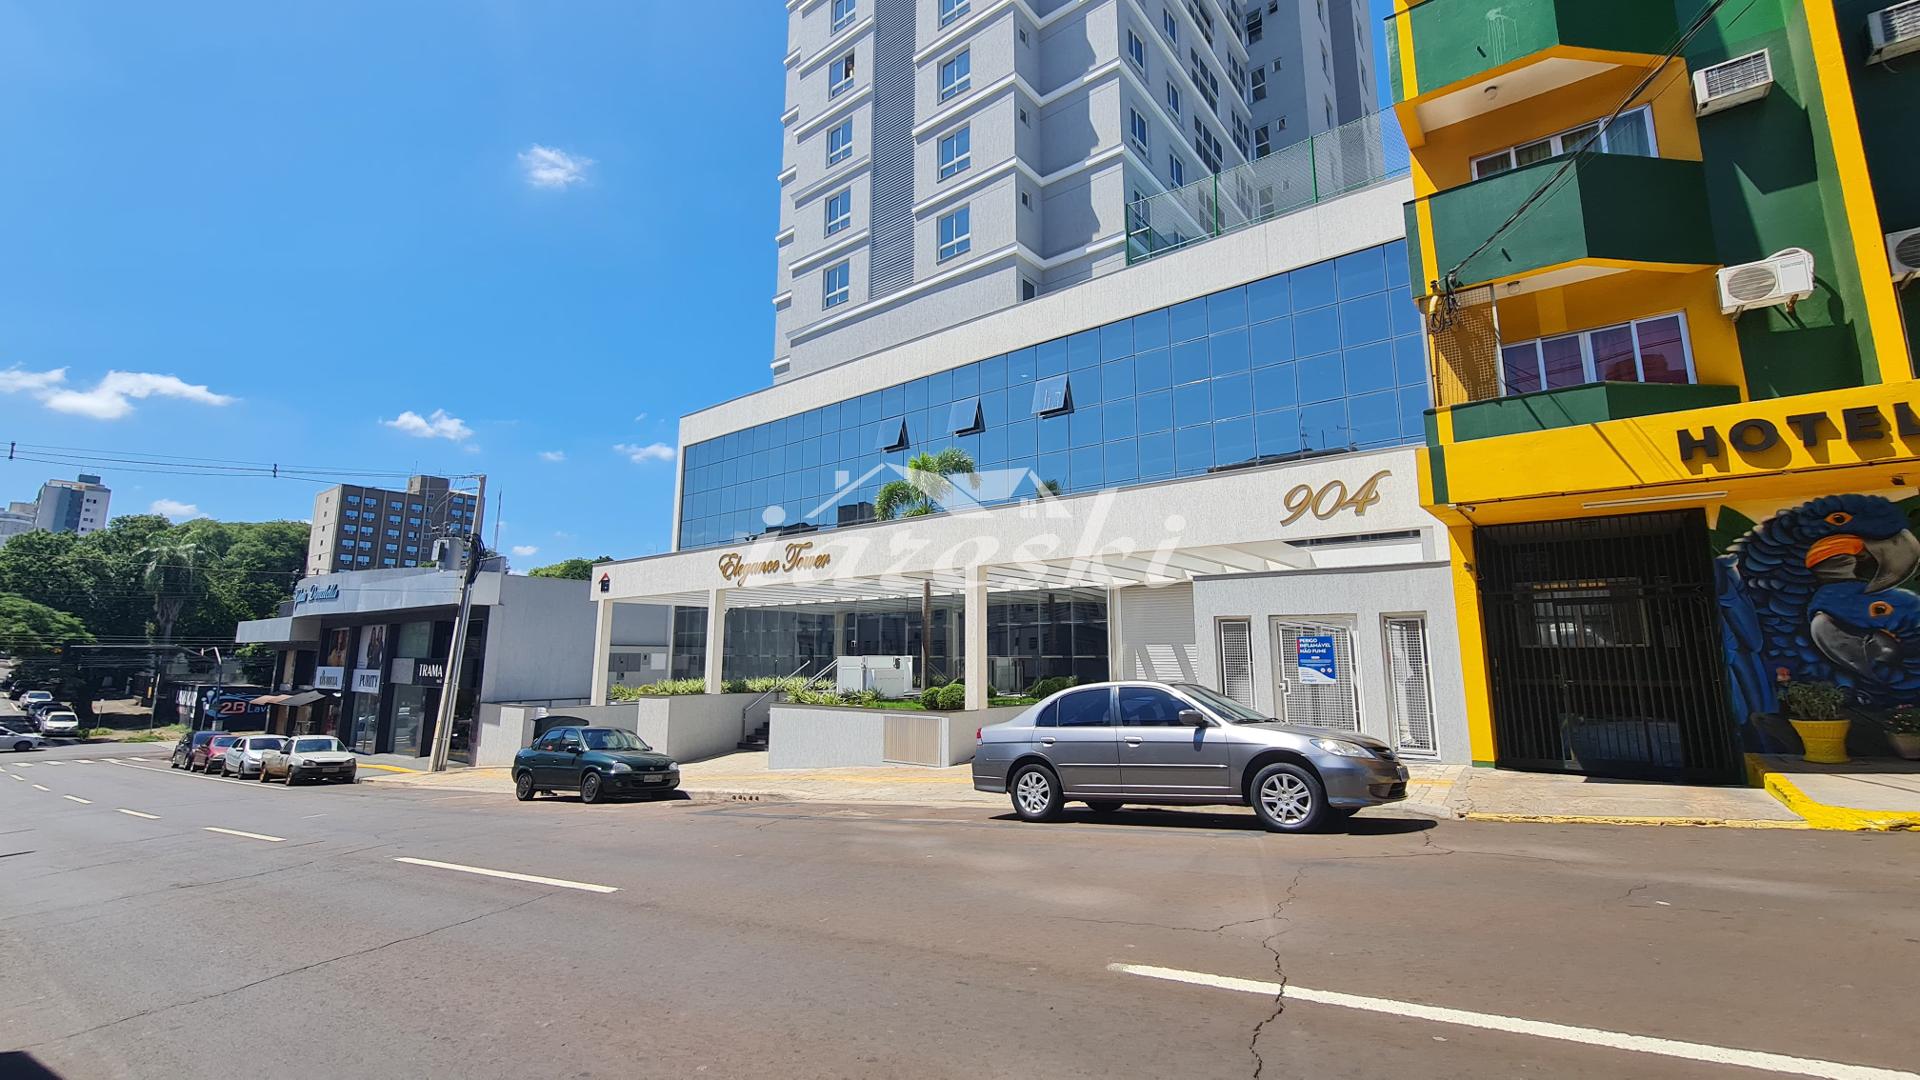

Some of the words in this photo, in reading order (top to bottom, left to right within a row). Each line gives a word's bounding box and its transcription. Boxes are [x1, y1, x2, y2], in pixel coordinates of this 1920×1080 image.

[1677, 401, 1920, 461] HOTEL
[1280, 469, 1392, 527] 904
[719, 552, 780, 587] Elegance
[782, 541, 831, 573] Tower
[419, 664, 443, 678] TRAMA
[220, 701, 246, 714] 2B
